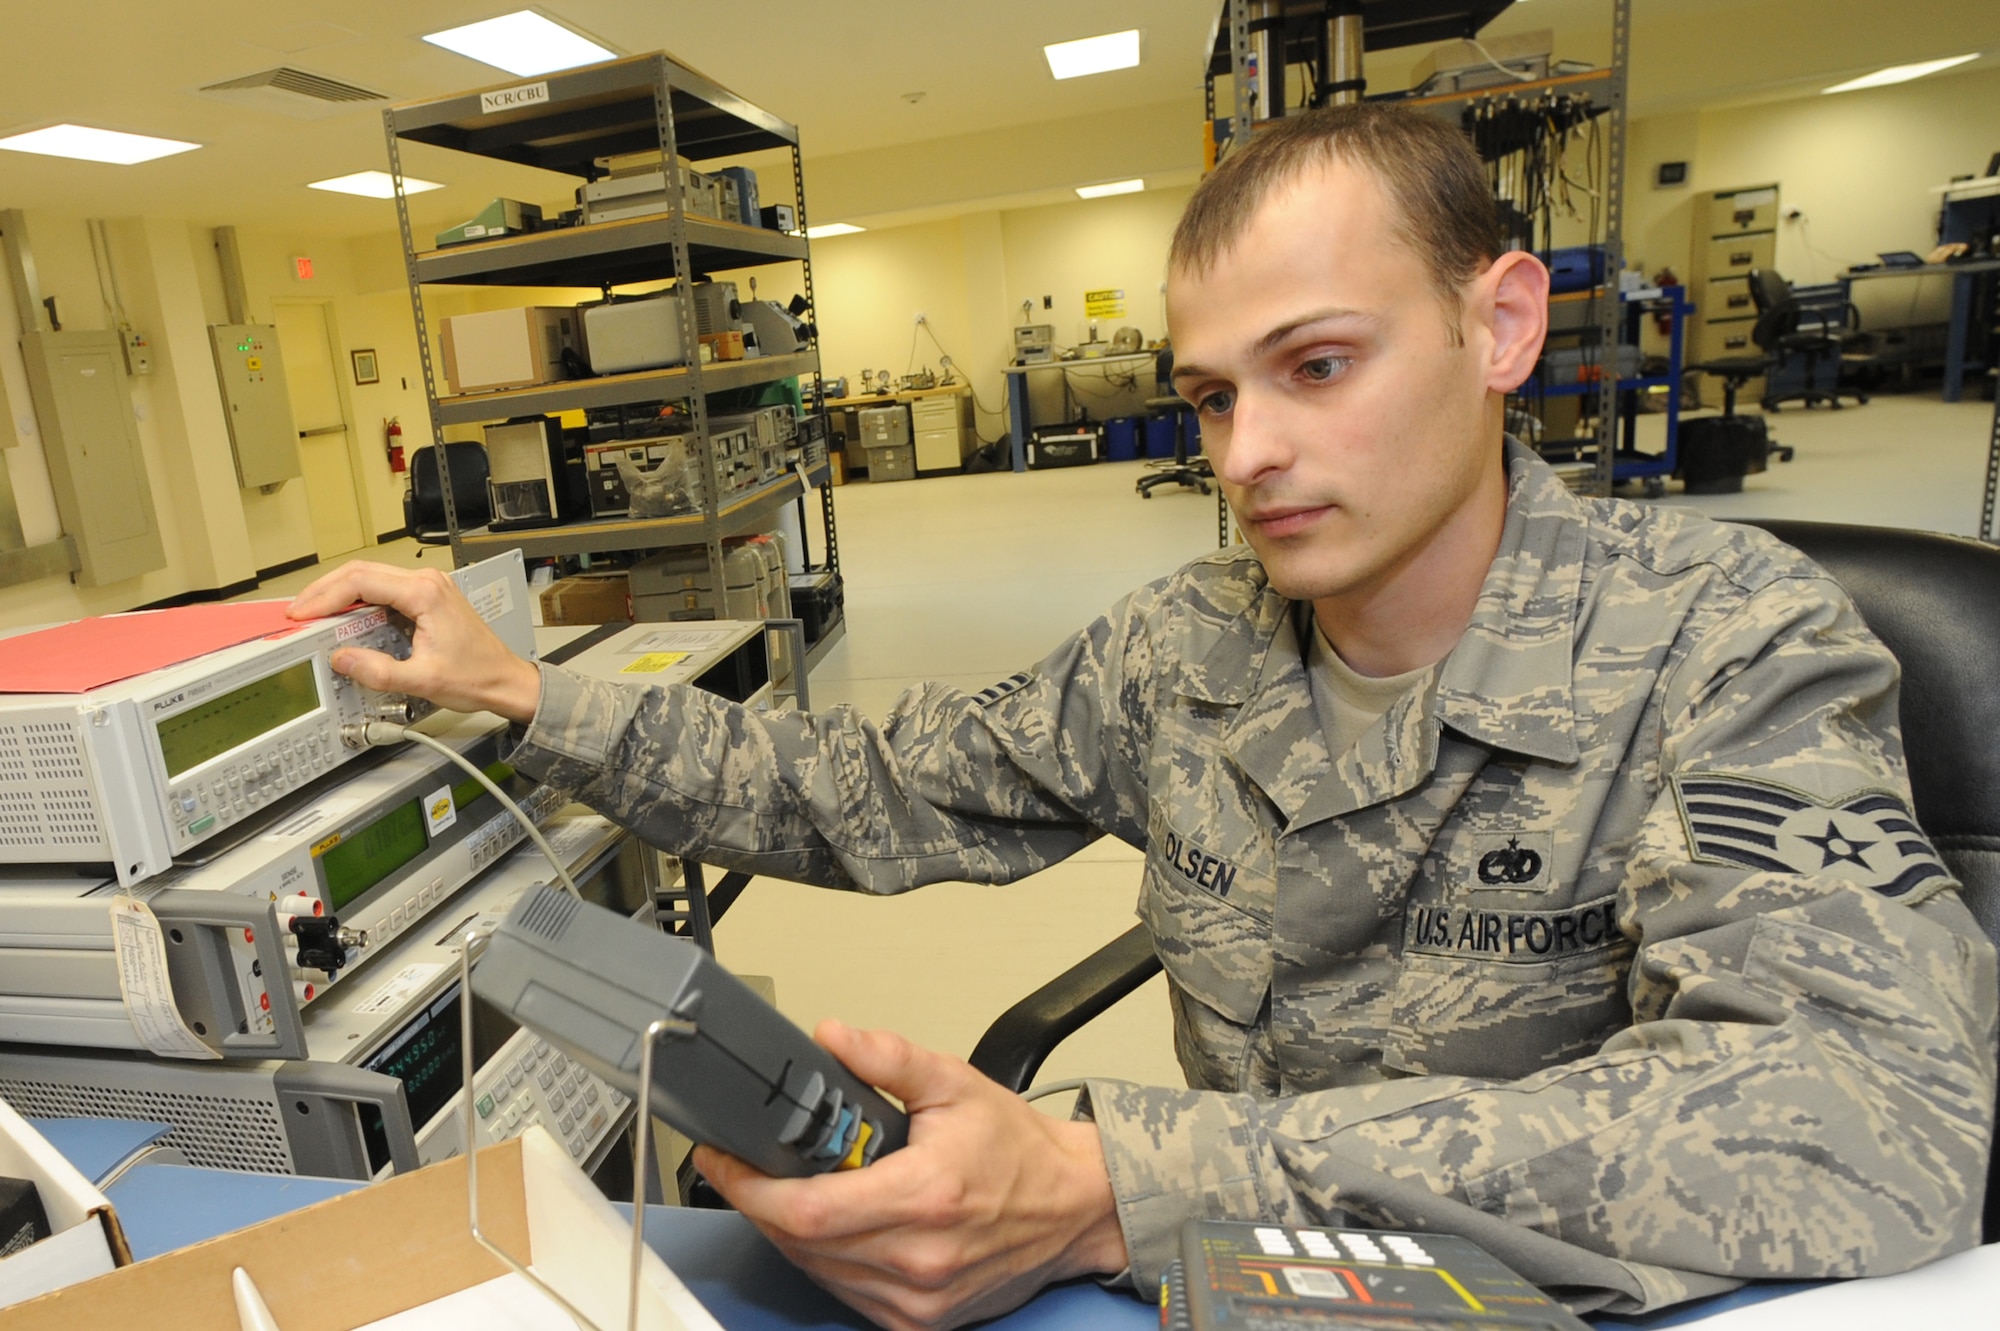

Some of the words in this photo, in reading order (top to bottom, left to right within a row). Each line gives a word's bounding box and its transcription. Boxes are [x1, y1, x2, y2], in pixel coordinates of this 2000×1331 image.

[485, 86, 545, 108] NCR/CBU
[338, 621, 363, 639] PATEC
[364, 611, 386, 629] CORE
[154, 694, 184, 711] FLUKE
[320, 835, 338, 850] FLUKE
[1166, 832, 1237, 897] OLSEN
[1416, 908, 1453, 947] U.S.
[1458, 912, 1501, 952] AIR
[1507, 902, 1624, 954] FORCE
